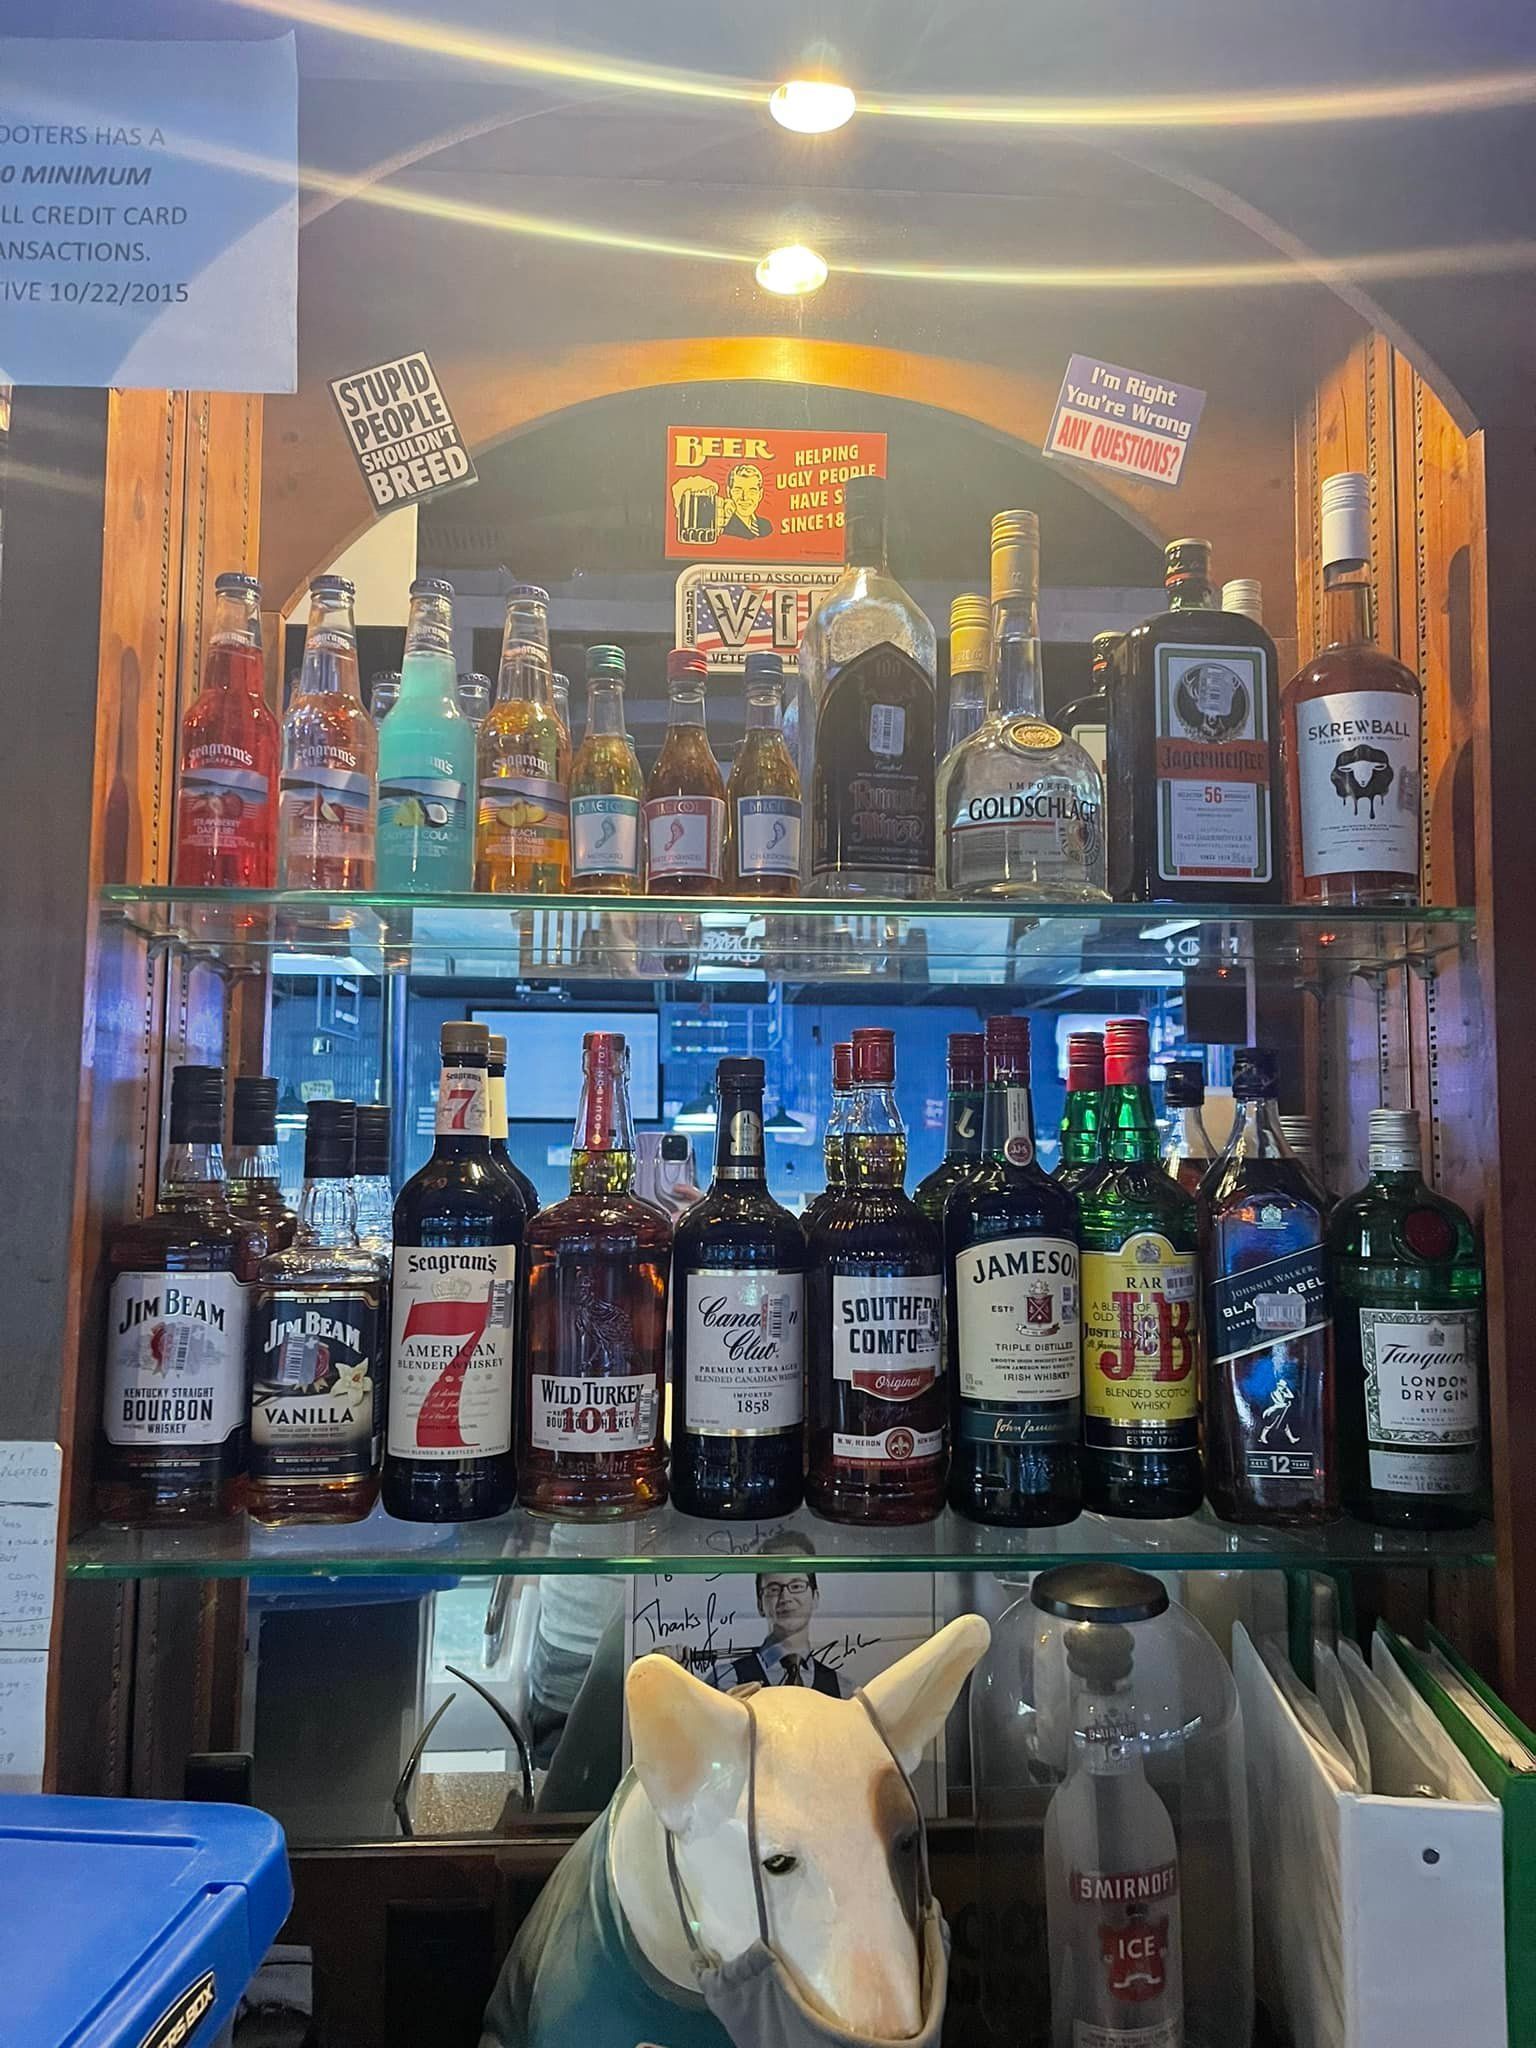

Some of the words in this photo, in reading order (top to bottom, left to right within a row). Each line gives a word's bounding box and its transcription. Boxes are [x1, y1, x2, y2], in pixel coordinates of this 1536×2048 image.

[95, 127, 142, 146] HAS
[149, 127, 165, 146] A
[21, 165, 152, 185] MINIMUM
[32, 206, 116, 225] CREDIT
[123, 207, 188, 225] CARD
[0, 281, 42, 301] IVE
[50, 281, 189, 306] 10/22/2015
[339, 358, 431, 417] STUPID
[1091, 366, 1121, 391] I'm
[1125, 376, 1178, 407] Right
[351, 392, 446, 450] PEOPLE
[1066, 384, 1126, 418] You're
[1131, 403, 1192, 439] Wrong
[361, 426, 458, 474] SHOULDN'T
[674, 435, 775, 467] BEER
[794, 444, 859, 467] HELPING
[1057, 415, 1092, 451] ANY
[1090, 424, 1180, 478] QUESTIONS?
[367, 445, 469, 506] BREED
[775, 470, 813, 490] UGLY
[789, 493, 828, 511] HAVE
[780, 515, 822, 535] SINCE
[825, 511, 845, 529] 18
[709, 572, 761, 584] UNITED
[1308, 719, 1411, 741] SKREWBALL
[1204, 786, 1223, 804] 56
[447, 1088, 478, 1130] 7
[407, 1253, 498, 1274] Seagram's
[973, 1250, 1079, 1284] JAMESON
[1126, 1276, 1163, 1289] RAR
[1231, 1280, 1274, 1302] JOHNNIE
[1091, 1302, 1099, 1311] A
[1137, 1303, 1152, 1313] OF
[1222, 1297, 1257, 1318] BLAC
[1276, 1276, 1326, 1296] ABEL
[119, 1297, 160, 1334] JIM
[164, 1288, 225, 1332] BEAM
[1093, 1311, 1114, 1322] OLD
[264, 1318, 303, 1353] JIM
[305, 1311, 362, 1353] BEAM
[723, 1329, 778, 1361] Club
[995, 1343, 1031, 1352] TRIPLE
[1034, 1341, 1073, 1351] DISTILLED
[397, 1360, 448, 1371] BLENDED
[401, 1279, 495, 1448] 7
[700, 1366, 745, 1375] PREMIUM
[748, 1366, 778, 1374] EXTRA
[695, 1374, 733, 1384] BLENDED
[735, 1373, 777, 1384] CANADIAN
[875, 1375, 921, 1391] Original
[1003, 1373, 1032, 1382] IRISH
[1033, 1371, 1071, 1382] WHISKEY
[1401, 1375, 1469, 1388] LONDON
[123, 1388, 169, 1398] KENTUCKY
[171, 1387, 214, 1398] STRAIGHT
[542, 1379, 581, 1405] WILD
[582, 1381, 644, 1407] TURKEY
[733, 1391, 773, 1399] IMPORTED
[1105, 1387, 1152, 1399] BLENDED
[1401, 1389, 1437, 1401] DRY
[1443, 1389, 1469, 1402] GIN
[122, 1399, 213, 1422] BOURBON
[265, 1407, 355, 1425] VANILLA
[737, 1399, 770, 1415] 1858
[1130, 1401, 1171, 1410] WHISKY
[147, 1423, 187, 1434] WHISKEY
[561, 1406, 620, 1435] 101
[994, 1418, 1022, 1440] John
[1269, 1455, 1291, 1473] 12
[632, 1598, 701, 1643] Thanks
[1080, 1866, 1176, 1900] SMIRNOFF
[1118, 1935, 1156, 1960] ICE
